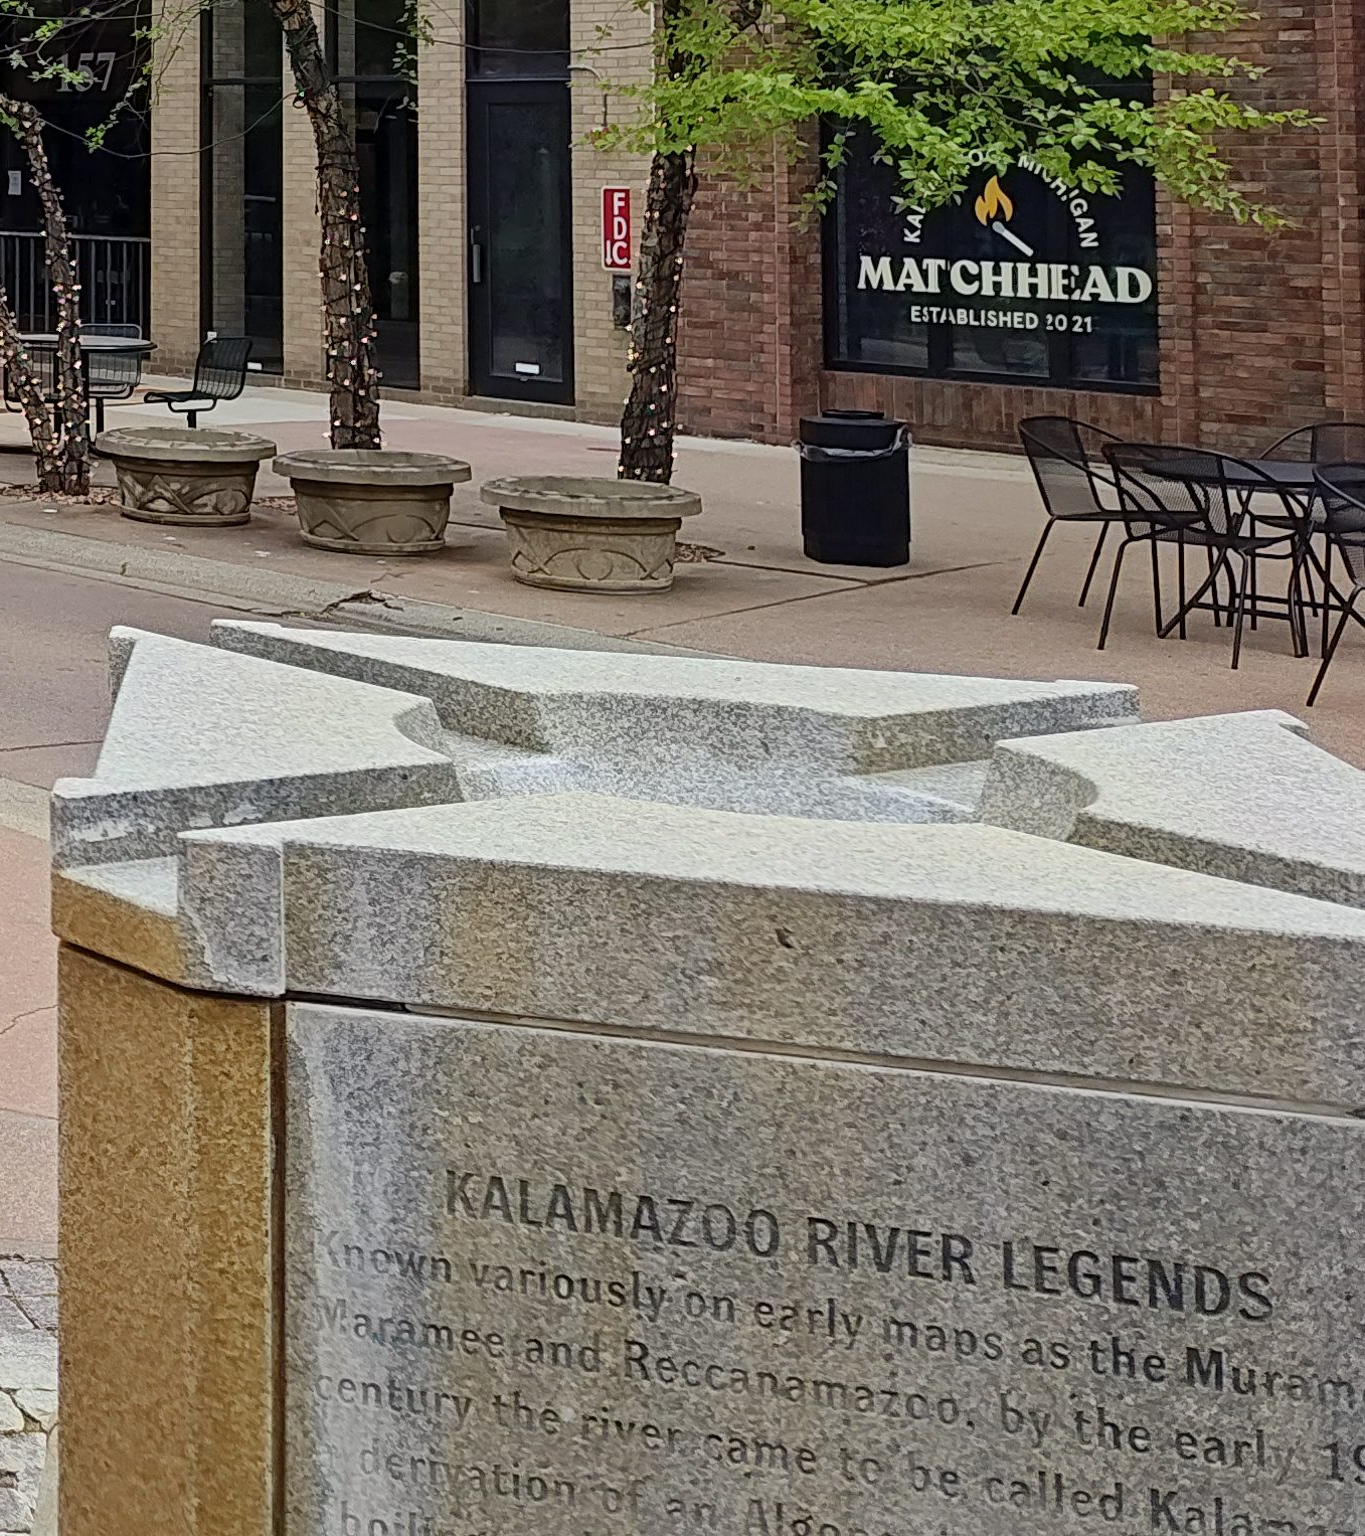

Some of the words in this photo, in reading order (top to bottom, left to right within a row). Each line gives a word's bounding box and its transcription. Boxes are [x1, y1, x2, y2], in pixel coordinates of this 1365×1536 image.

[56, 52, 117, 93] 157
[856, 255, 1154, 304] MATCHHEAD
[910, 305, 1039, 330] ESTABLISHED
[1045, 314, 1093, 333] 2021
[446, 1169, 781, 1259] KALAMAZOO
[806, 1216, 977, 1286] RIVER
[1001, 1240, 1273, 1322] LEGENDS
[317, 1295, 506, 1359] Maramee
[525, 1331, 601, 1373] and
[999, 1389, 1051, 1449] by
[1072, 1405, 1153, 1454] the
[469, 1260, 668, 1322] variously
[684, 1291, 737, 1323] on
[753, 1298, 864, 1351] early
[883, 1314, 1005, 1363] maps
[1021, 1336, 1071, 1371] as
[1087, 1335, 1167, 1383] the
[1185, 1345, 1365, 1409] Muram
[315, 1373, 473, 1432] century
[491, 1390, 562, 1437] the
[582, 1407, 682, 1452] river
[703, 1431, 818, 1476] came
[839, 1446, 881, 1485] to
[909, 1451, 963, 1498] be
[985, 1469, 1126, 1524] called
